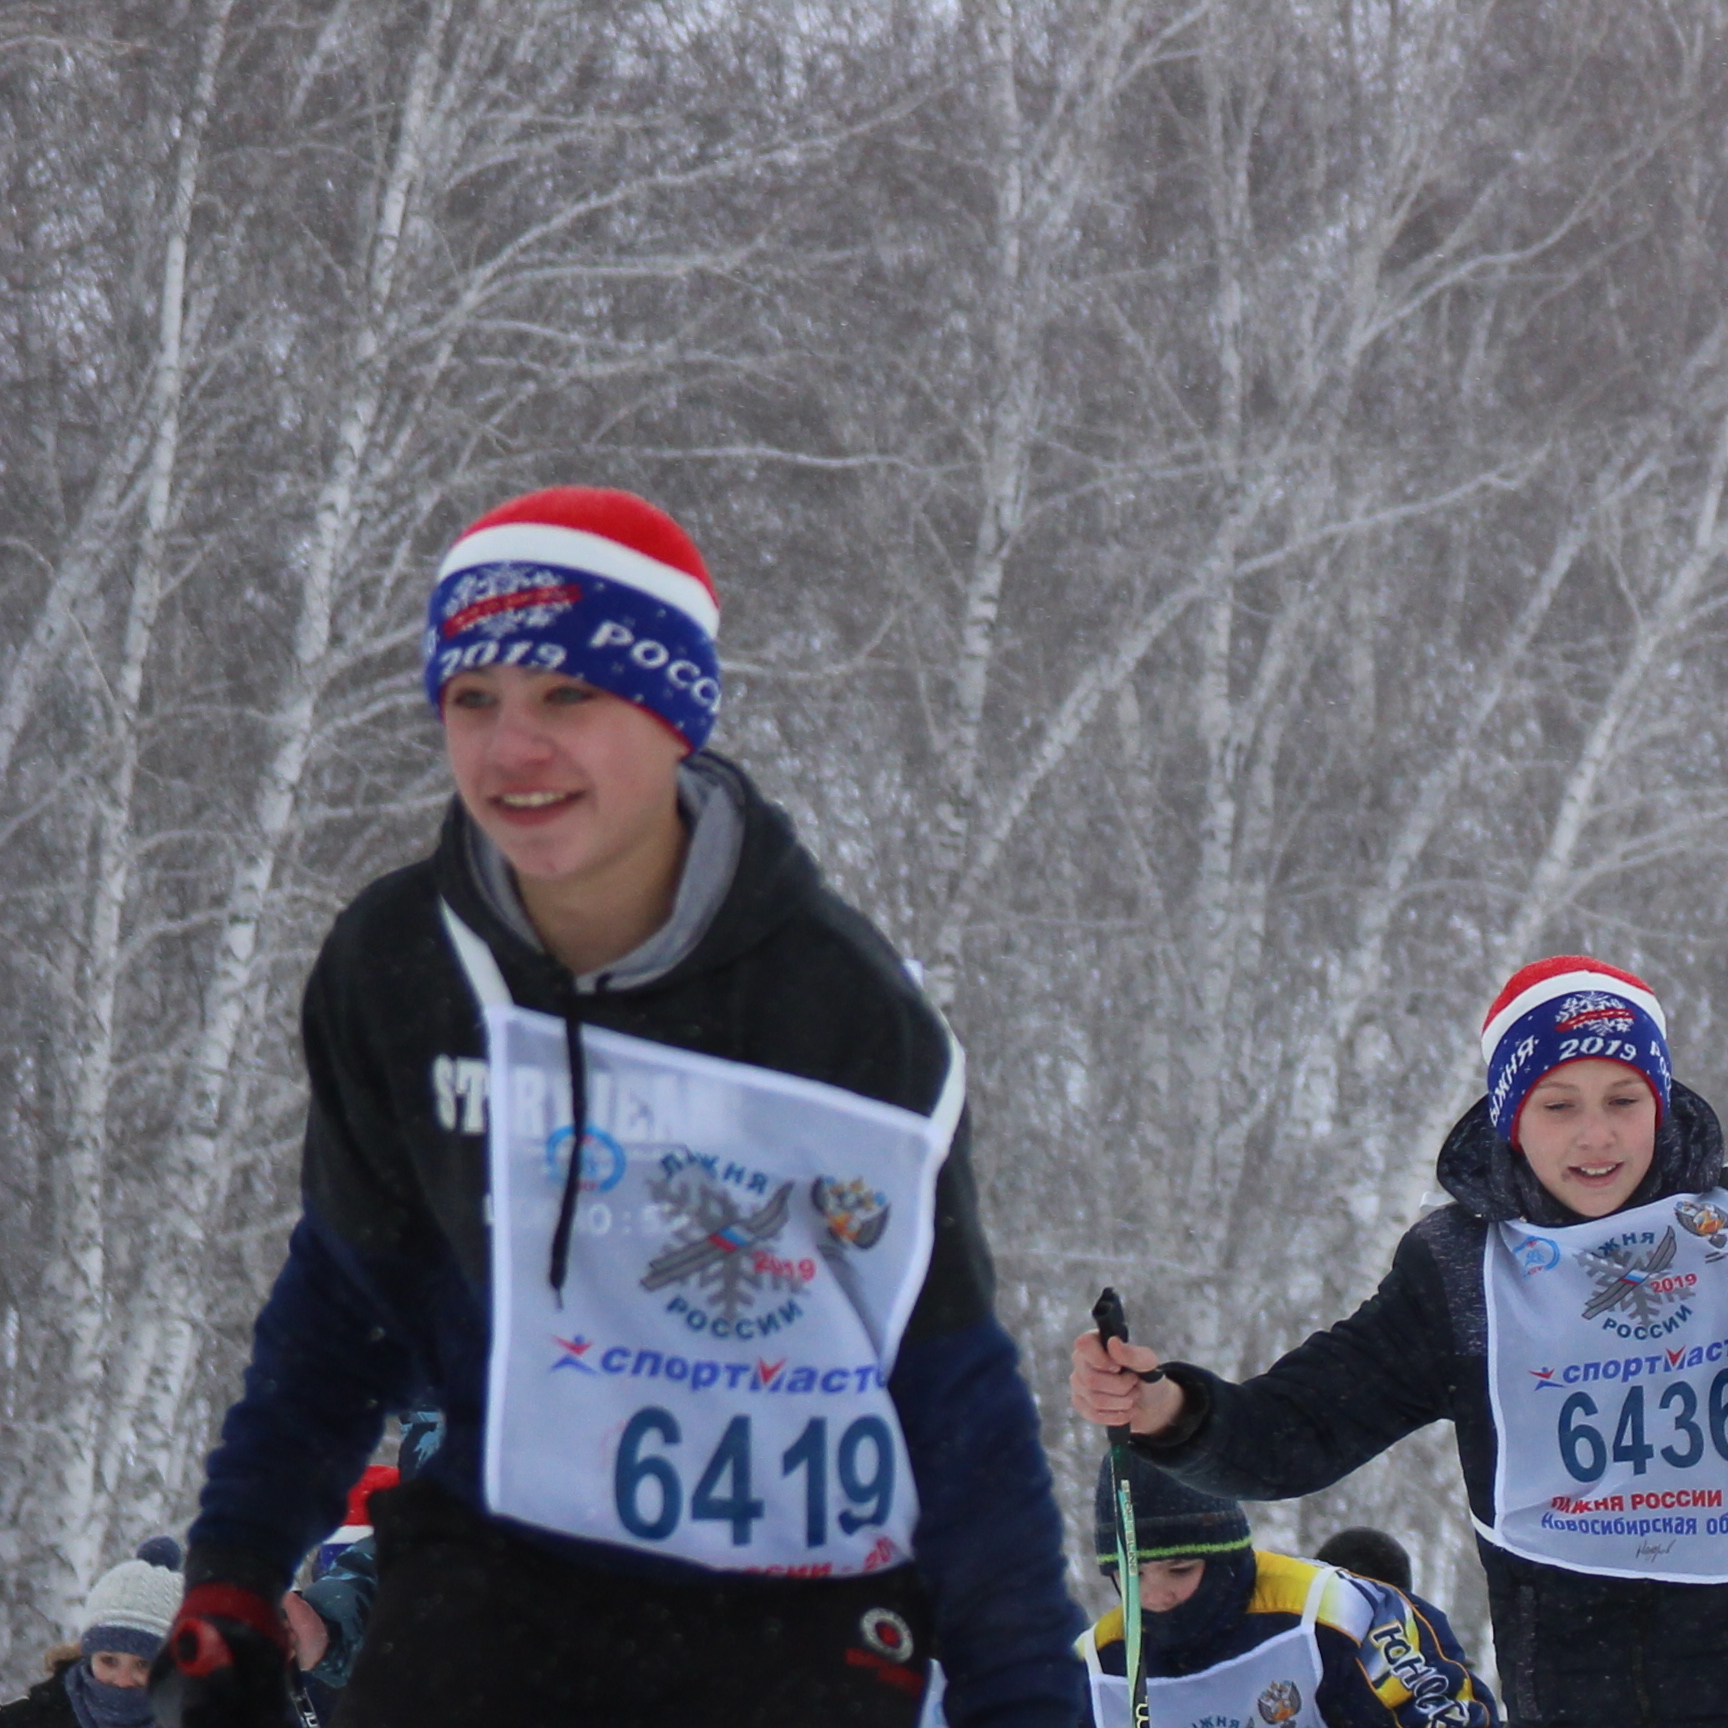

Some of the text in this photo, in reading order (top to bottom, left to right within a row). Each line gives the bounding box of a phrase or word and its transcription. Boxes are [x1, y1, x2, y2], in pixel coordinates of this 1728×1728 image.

[1489, 1034, 1536, 1128] ЫЖНЯ
[1558, 1036, 1638, 1062] 2019
[1650, 1272, 1698, 1294] 2019
[665, 1294, 804, 1340] РОССИИ
[1602, 1304, 1693, 1341] РОССИИ
[614, 1406, 897, 1549] 6419
[1631, 1489, 1723, 1511] РОССИИ
[1541, 1512, 1698, 1537] Новосибирская
